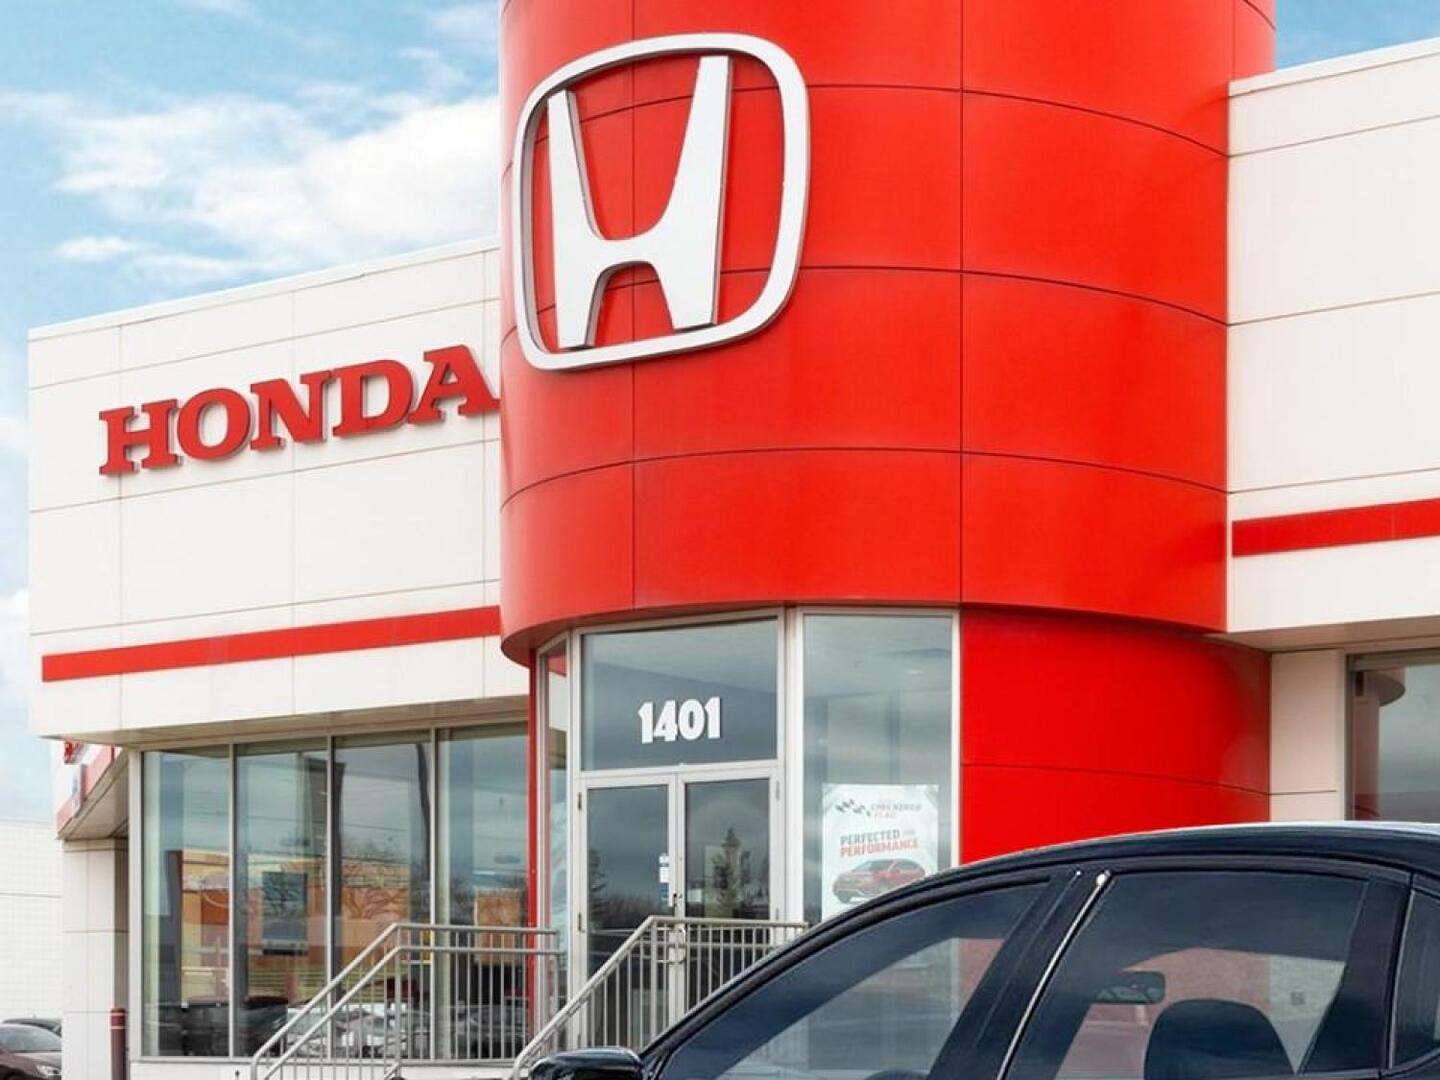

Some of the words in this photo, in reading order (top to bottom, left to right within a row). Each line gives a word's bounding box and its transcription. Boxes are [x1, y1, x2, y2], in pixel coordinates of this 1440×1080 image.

[99, 344, 500, 476] HONDA
[638, 696, 721, 744] 1401
[840, 829, 901, 846] PERFECTED
